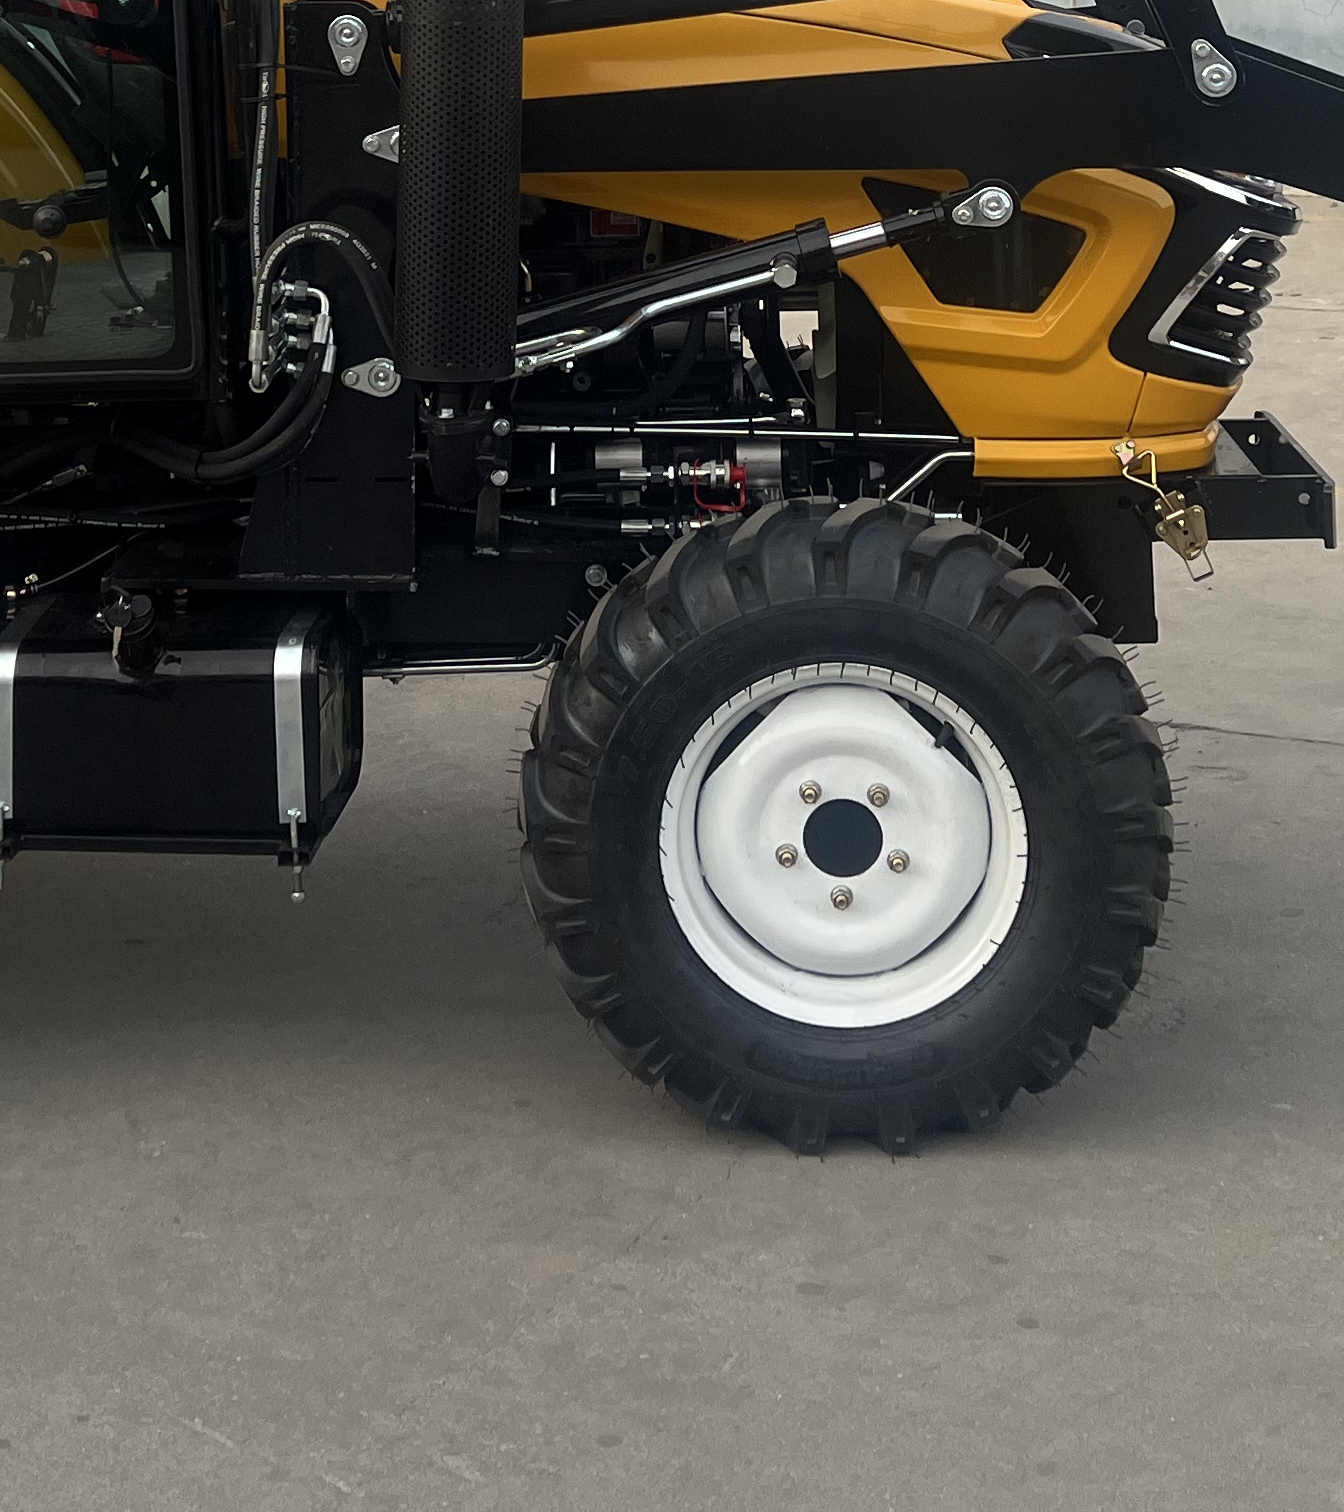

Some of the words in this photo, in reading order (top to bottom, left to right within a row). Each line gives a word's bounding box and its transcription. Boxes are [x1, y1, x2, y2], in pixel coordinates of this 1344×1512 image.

[257, 125, 266, 165] PRESSURE
[253, 190, 261, 224] BRAIDED
[261, 243, 286, 280] PRESSURE
[257, 283, 265, 304] WIRE
